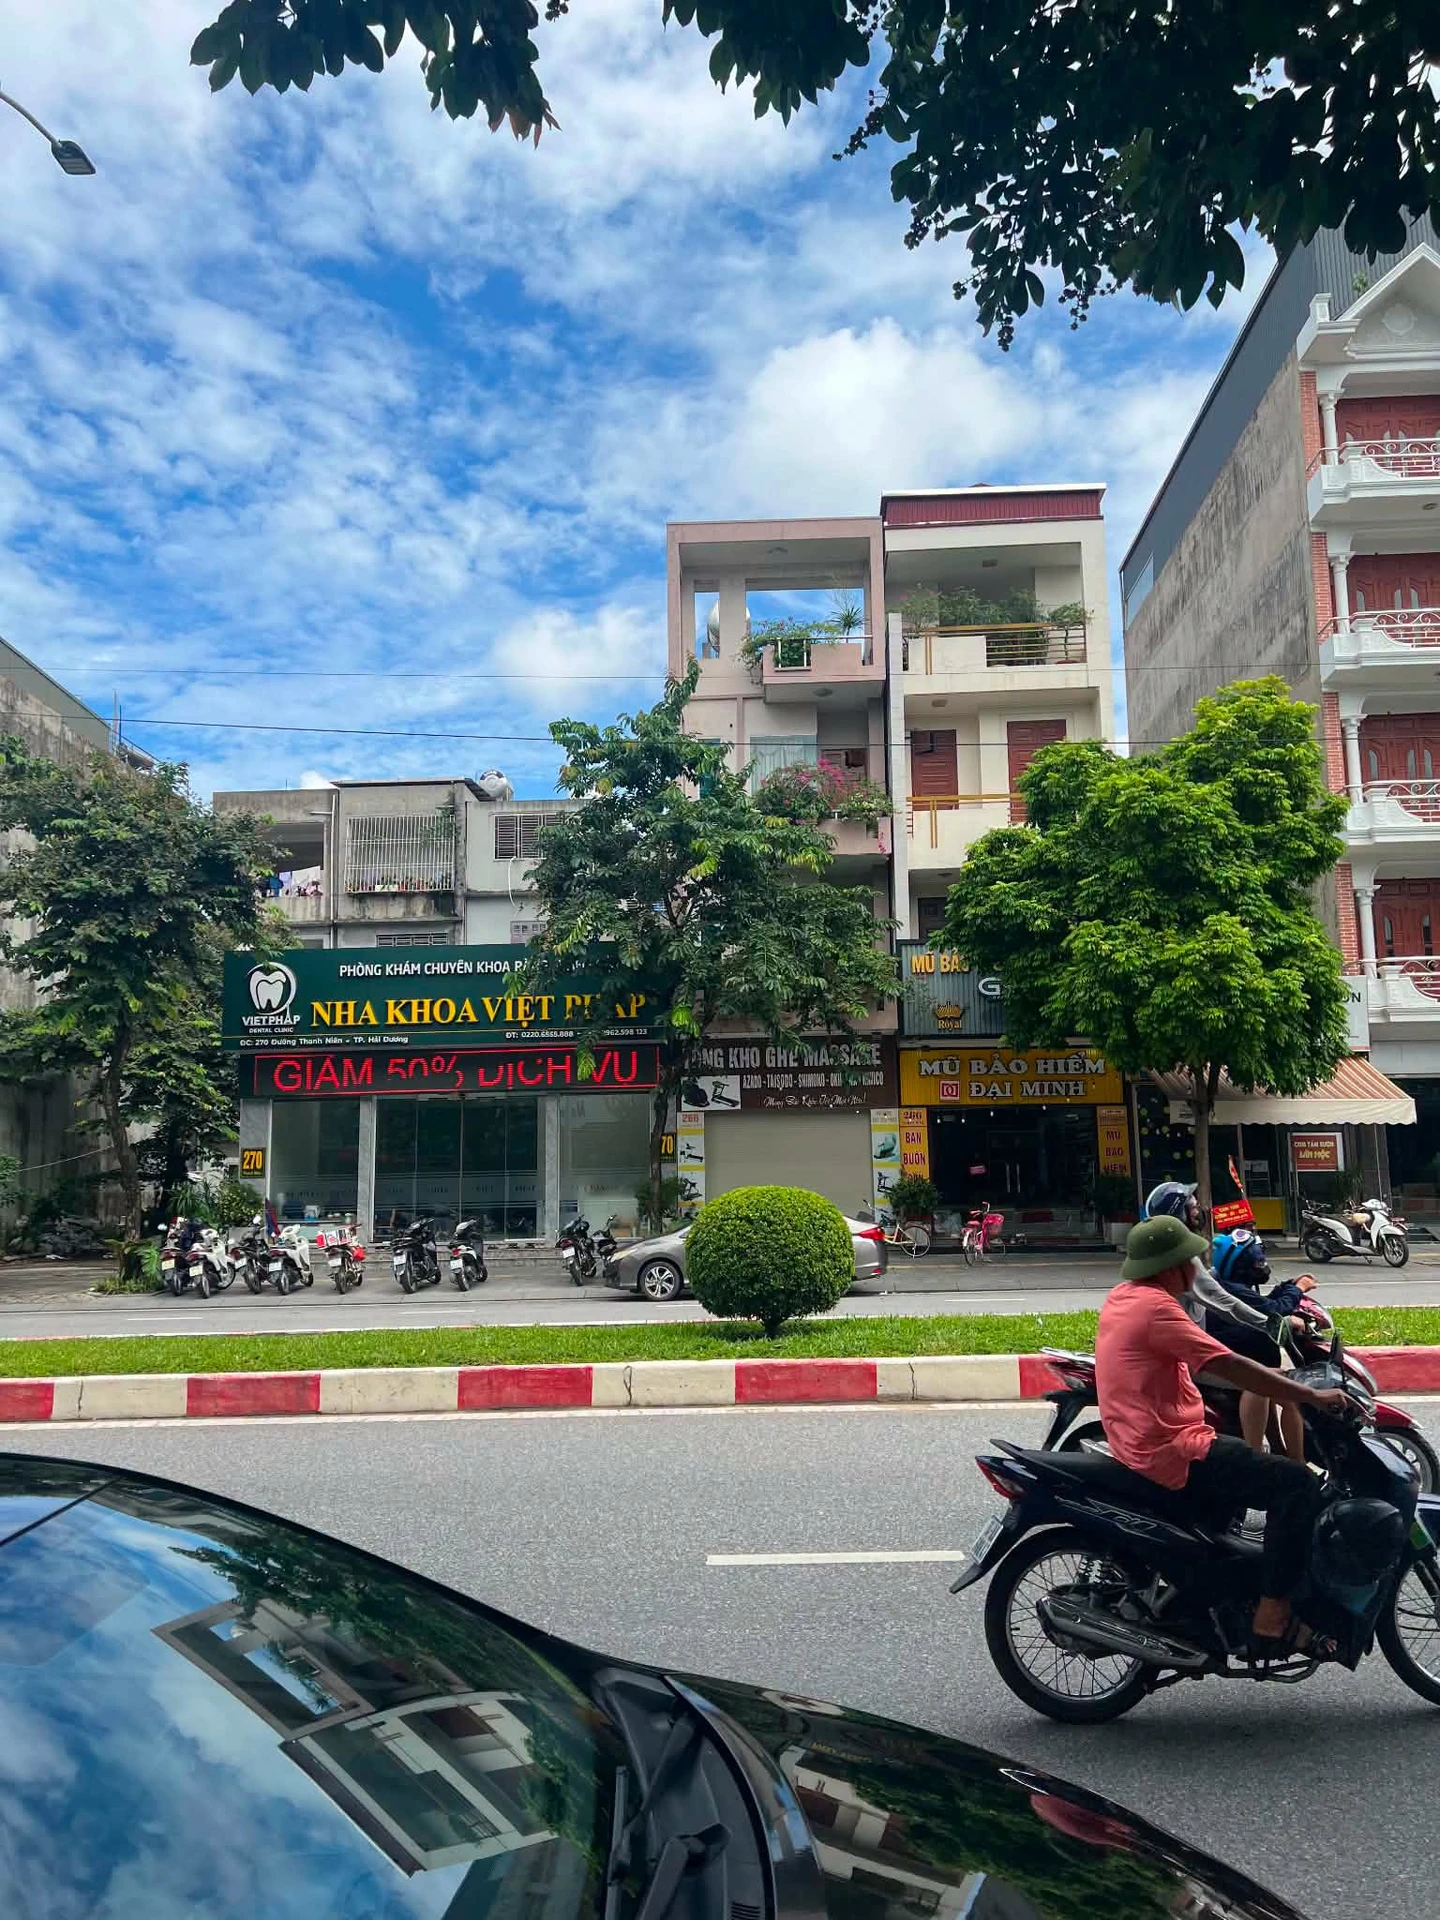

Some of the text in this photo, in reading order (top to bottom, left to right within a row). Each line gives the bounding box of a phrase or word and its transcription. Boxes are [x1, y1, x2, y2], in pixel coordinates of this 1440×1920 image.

[339, 961, 382, 977] PHÒNG
[385, 960, 421, 976] KHÁM
[424, 959, 472, 975] CHUYÊN
[476, 960, 511, 973] KHOA
[911, 950, 935, 973] MŨ
[310, 1000, 379, 1027] NHA
[385, 997, 479, 1025] KHOA
[481, 992, 555, 1028] VIỆT
[938, 1019, 962, 1031] Royal
[728, 1046, 760, 1069] KHO
[919, 1050, 1106, 1076] MŨ BẢO HIỂM
[969, 1081, 1085, 1099] ĐẠI MINH
[242, 1150, 263, 1170] 270
